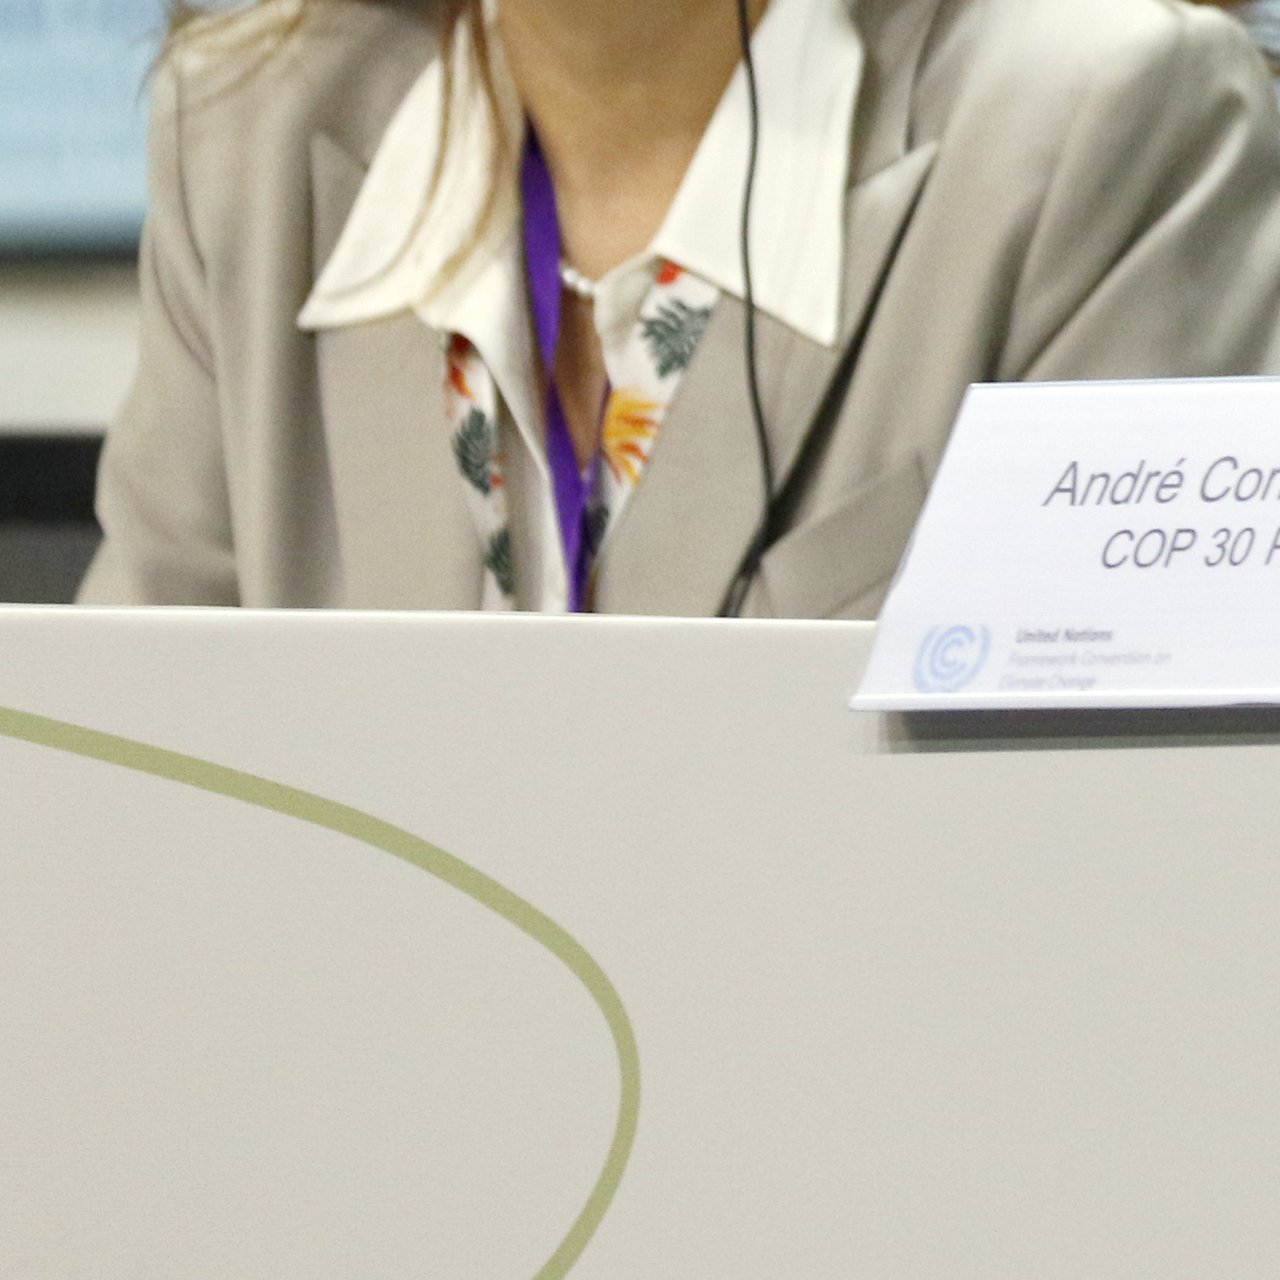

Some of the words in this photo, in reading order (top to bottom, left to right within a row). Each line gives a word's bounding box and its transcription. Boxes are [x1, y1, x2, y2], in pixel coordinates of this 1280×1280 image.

[1042, 457, 1187, 507] André
[1101, 528, 1198, 569] COP
[1204, 526, 1256, 568] 30
